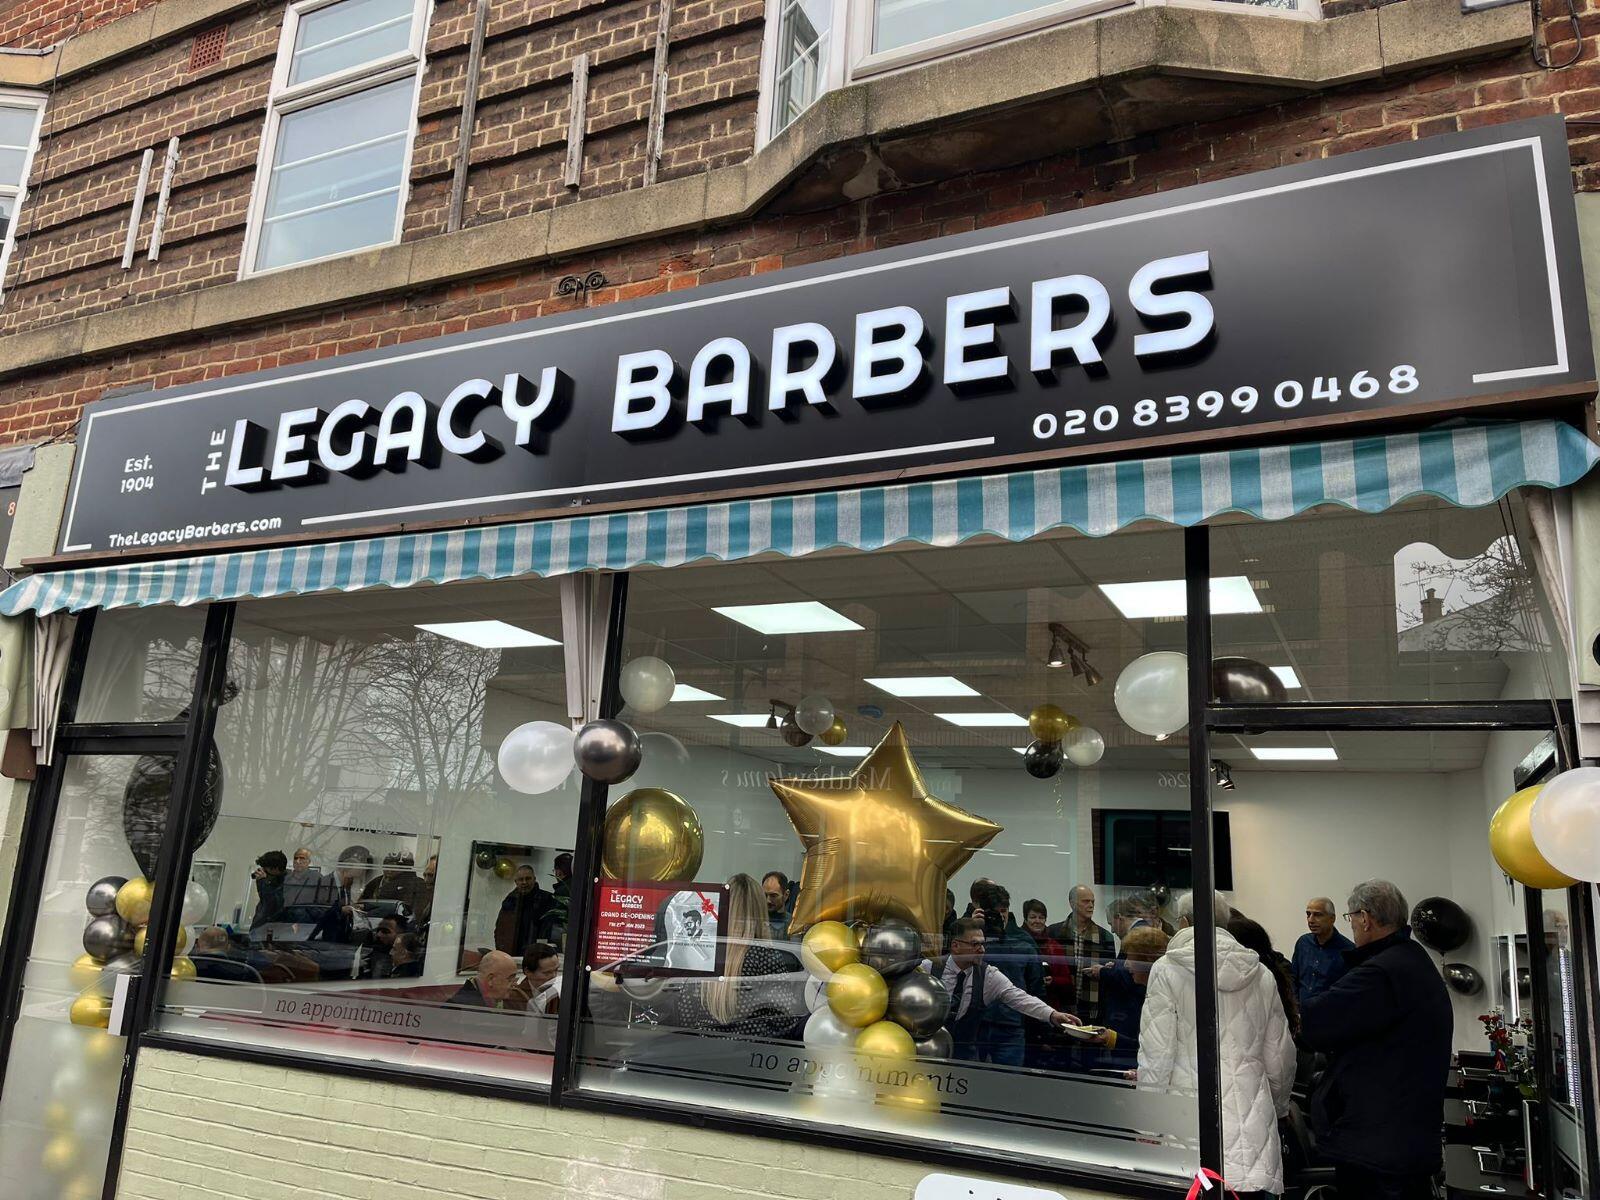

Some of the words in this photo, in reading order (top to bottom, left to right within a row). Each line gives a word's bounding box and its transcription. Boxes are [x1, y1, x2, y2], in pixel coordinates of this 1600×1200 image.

[201, 429, 226, 495] THE
[225, 367, 558, 487] LEGACY
[611, 250, 1215, 433] BARBERS
[1032, 405, 1120, 439] 020
[1133, 385, 1259, 427] 8399
[1273, 364, 1420, 409] 0468
[124, 454, 153, 473] Est.
[120, 476, 154, 493] 1904
[109, 516, 282, 548] TheLegacyBarbers.com
[610, 894, 644, 904] LEGACY
[620, 912, 655, 920] RE-OPENING
[274, 999, 297, 1014] no
[301, 1001, 422, 1029] appointments
[750, 1050, 779, 1071] no
